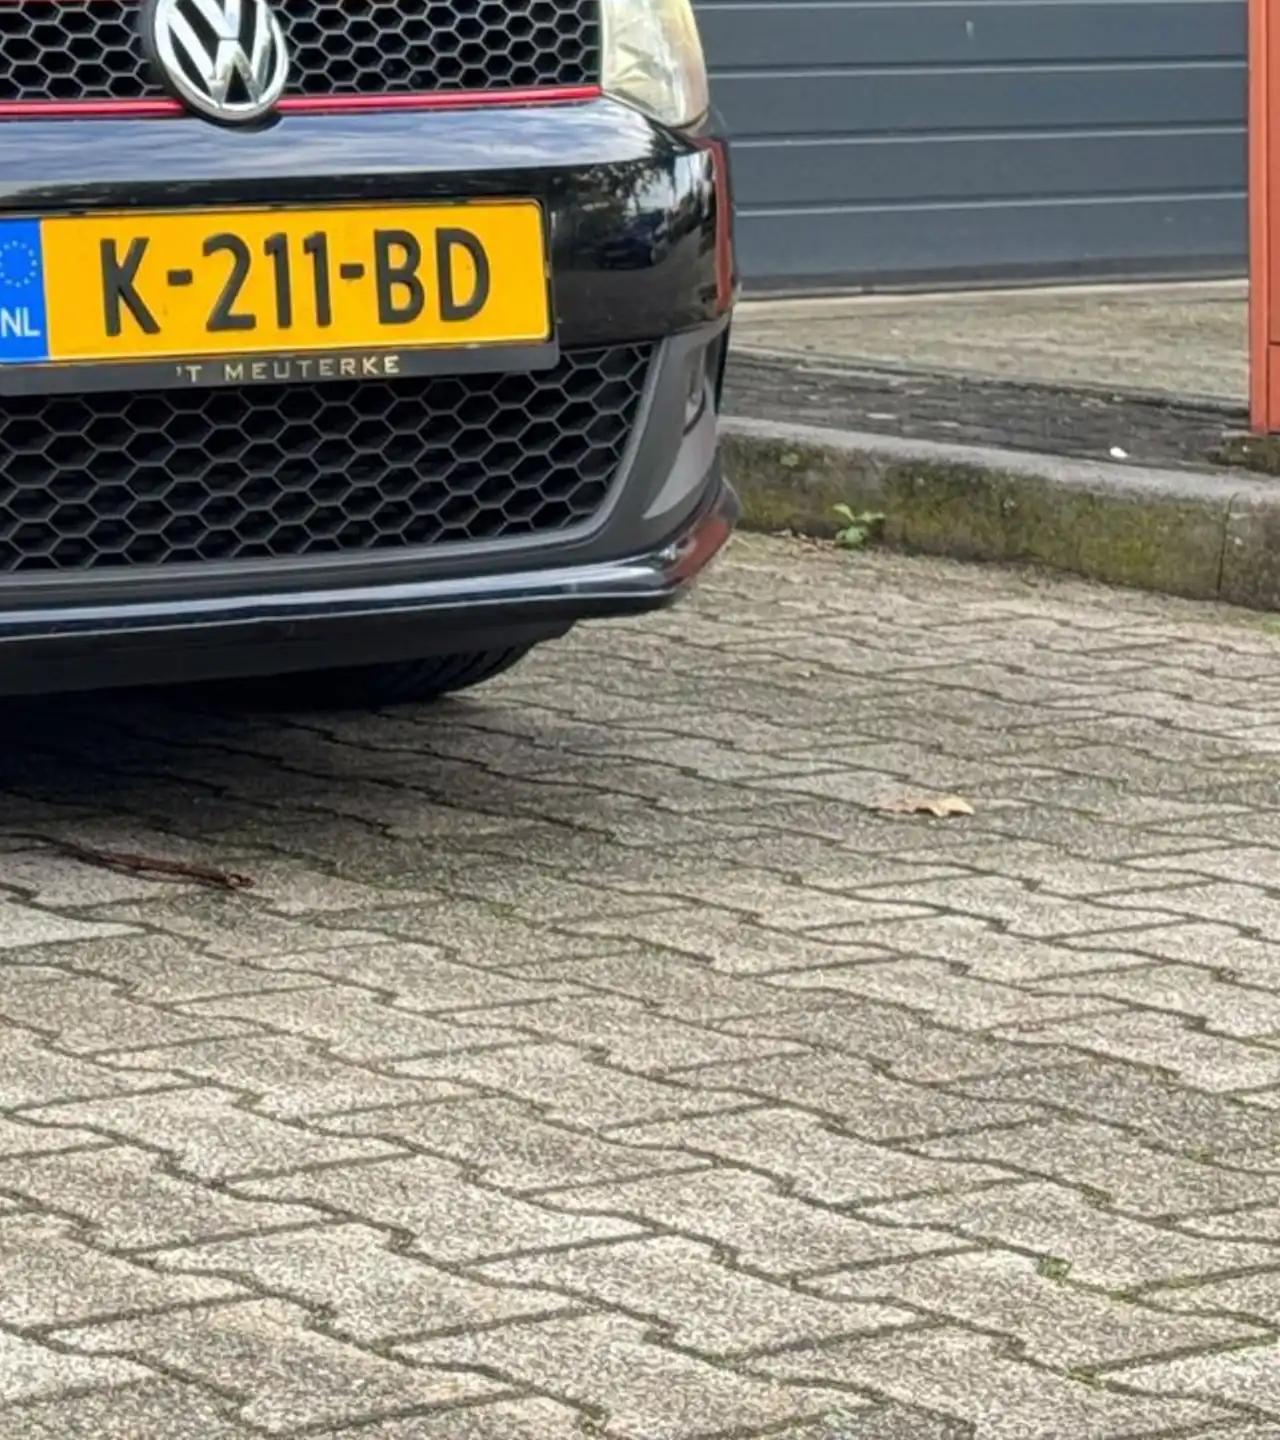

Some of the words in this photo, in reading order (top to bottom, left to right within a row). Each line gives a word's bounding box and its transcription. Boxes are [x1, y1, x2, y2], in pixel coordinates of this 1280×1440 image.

[100, 226, 491, 338] K-211-BD
[0, 306, 40, 338] NL
[224, 354, 401, 382] MEUTERKE
